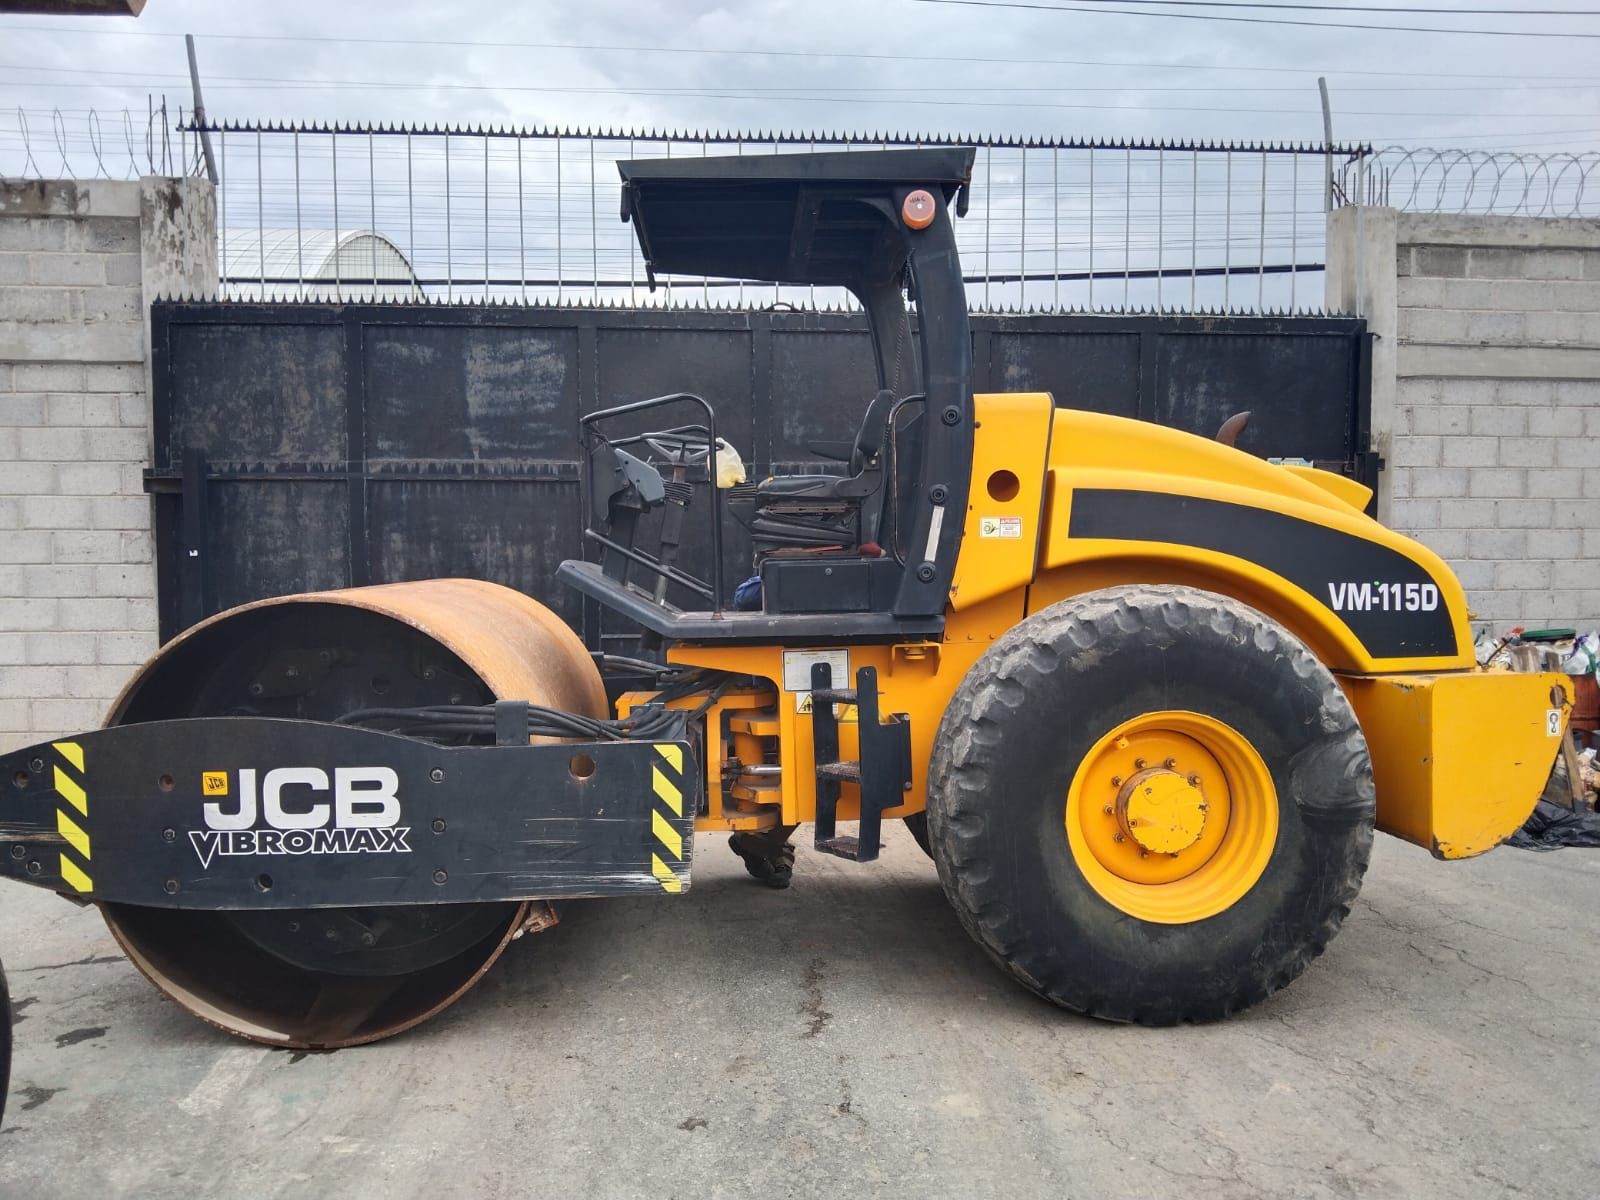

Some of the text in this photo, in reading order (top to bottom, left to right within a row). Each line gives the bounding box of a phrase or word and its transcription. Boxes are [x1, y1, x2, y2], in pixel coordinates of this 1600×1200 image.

[1328, 582, 1438, 611] VM-115D
[203, 766, 401, 831] JCB
[207, 777, 225, 789] JCB
[188, 827, 412, 870] VIBROMAX
